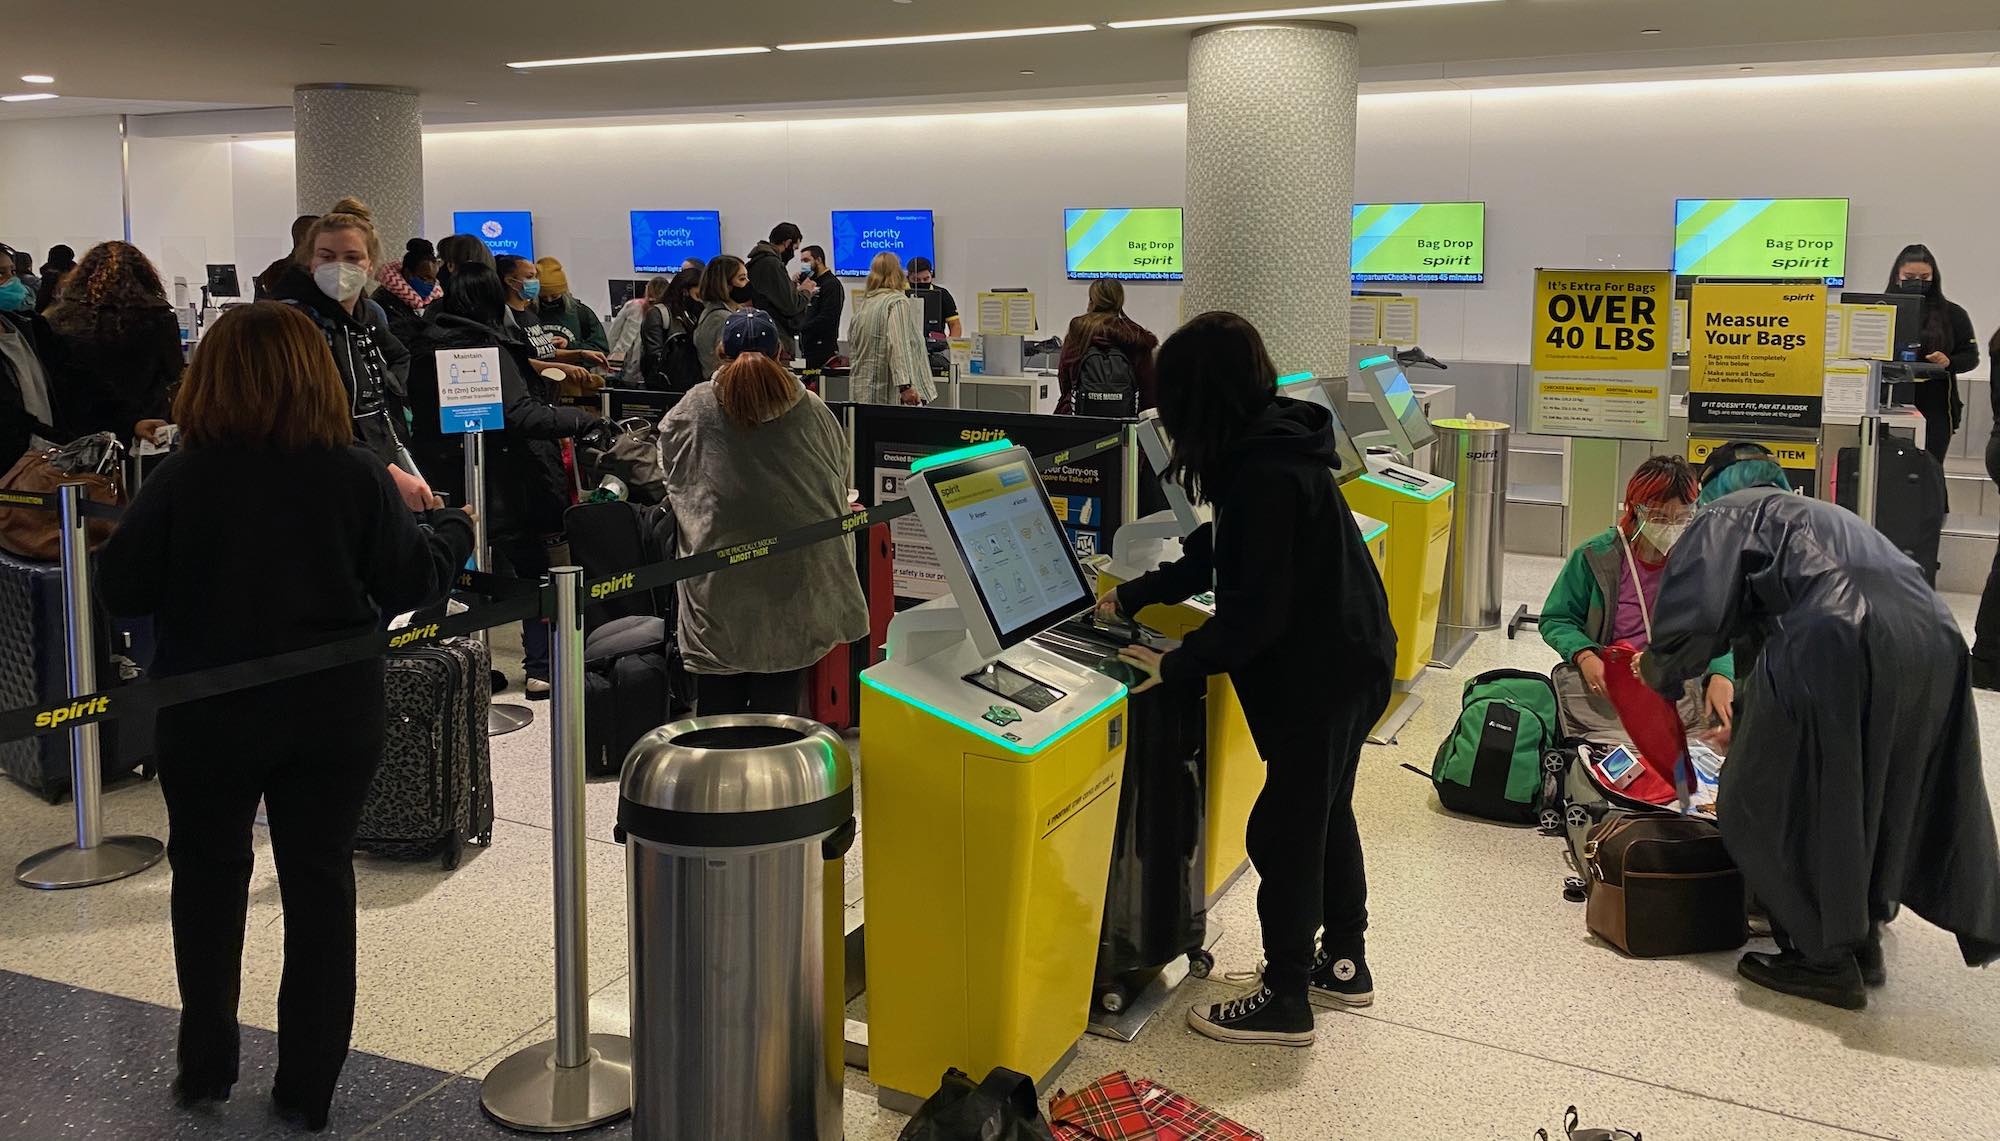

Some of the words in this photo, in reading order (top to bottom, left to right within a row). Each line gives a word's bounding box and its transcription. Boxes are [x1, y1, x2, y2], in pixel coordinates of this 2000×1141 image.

[658, 228, 691, 238] priority
[862, 228, 900, 240] priority
[484, 240, 518, 248] country
[656, 238, 694, 246] check-in
[860, 239, 904, 248] check-in
[1128, 241, 1147, 250] Bag
[1150, 241, 1174, 250] Drop
[1417, 240, 1440, 250] Bag
[1444, 240, 1474, 250] Drop
[1766, 240, 1794, 250] Bag
[1798, 239, 1834, 250] Drop
[1133, 256, 1174, 266] spirit
[1422, 256, 1472, 268] spirit
[1772, 257, 1830, 270] spirit
[1548, 281, 1567, 290] It's
[1570, 282, 1601, 292] Extra
[1604, 282, 1624, 292] For
[1627, 283, 1656, 294] Bags
[1782, 294, 1816, 302] spirit
[1548, 294, 1656, 325] OVER
[1706, 312, 1790, 328] Measure
[1546, 326, 1585, 349] 40
[1595, 326, 1655, 352] LBS
[1705, 330, 1751, 345] Your
[1757, 331, 1806, 350] Bags
[1088, 392, 1102, 400] STEVE
[464, 419, 480, 427] LAX
[960, 428, 1006, 442] spirit
[884, 454, 907, 462] Checked
[1466, 450, 1498, 460] spirit
[1777, 450, 1805, 460] ITEM
[1062, 466, 1098, 476] Carry-ons
[940, 484, 961, 498] spirit
[841, 511, 869, 531] spirit
[730, 550, 751, 565] ALMOST
[753, 546, 769, 558] THERE
[900, 569, 917, 577] safety
[590, 572, 636, 599] spirit
[389, 623, 440, 648] spirit
[34, 696, 112, 728] spirit
